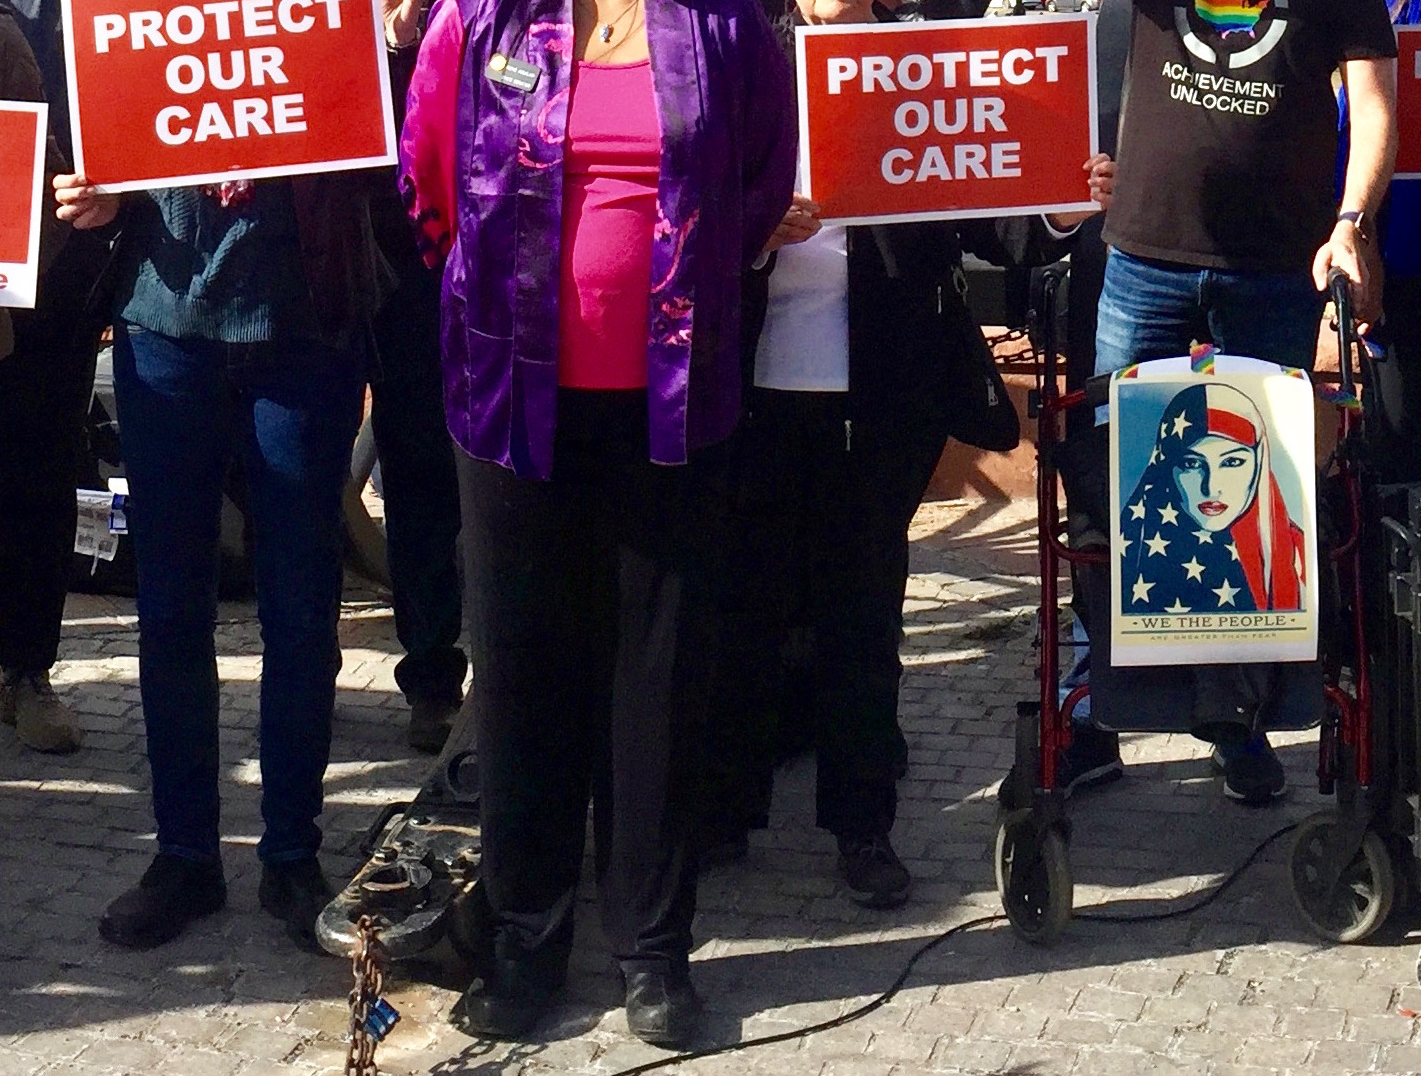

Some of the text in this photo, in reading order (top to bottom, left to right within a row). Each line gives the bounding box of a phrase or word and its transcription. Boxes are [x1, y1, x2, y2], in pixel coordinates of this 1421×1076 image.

[165, 46, 289, 94] OUR
[827, 45, 1069, 95] PROTECT
[1162, 61, 1285, 99] ACHIEVEMENT
[155, 92, 307, 145] CARE
[894, 96, 1008, 138] OUR
[1170, 83, 1269, 116] UNLOCKED
[880, 141, 1022, 185] CARE
[1141, 615, 1287, 628] WE THE PEOPLE
